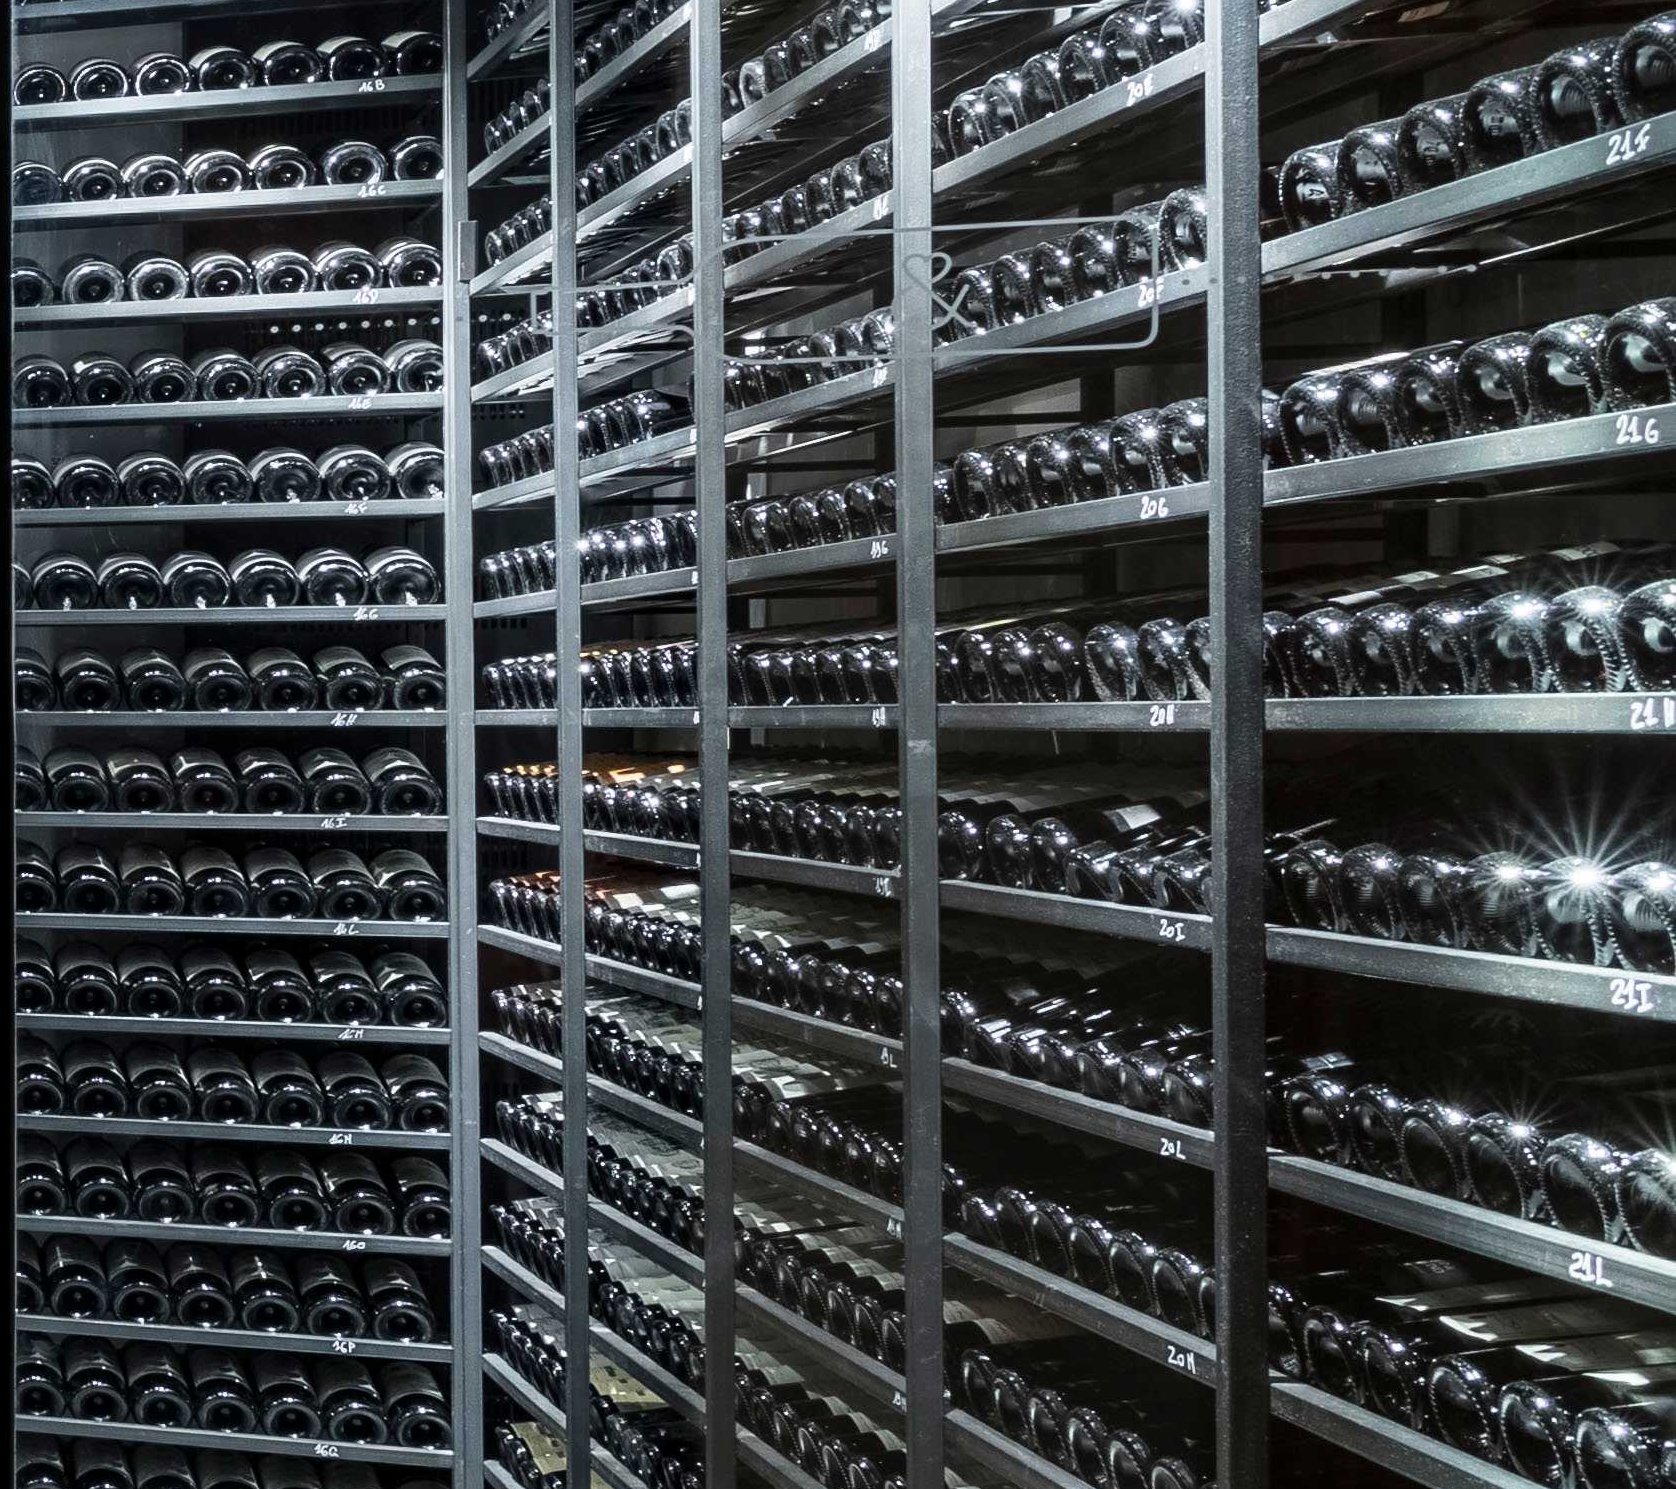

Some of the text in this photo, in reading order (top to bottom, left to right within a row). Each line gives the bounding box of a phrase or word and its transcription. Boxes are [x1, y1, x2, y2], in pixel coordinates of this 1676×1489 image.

[359, 78, 385, 94] 16B
[1615, 412, 1660, 445] 21G
[1158, 918, 1186, 942] 20I
[1609, 977, 1655, 1013] 21I
[1159, 1137, 1186, 1160] 20L
[1568, 1251, 1613, 1288] 21L
[332, 1339, 356, 1354] 16P
